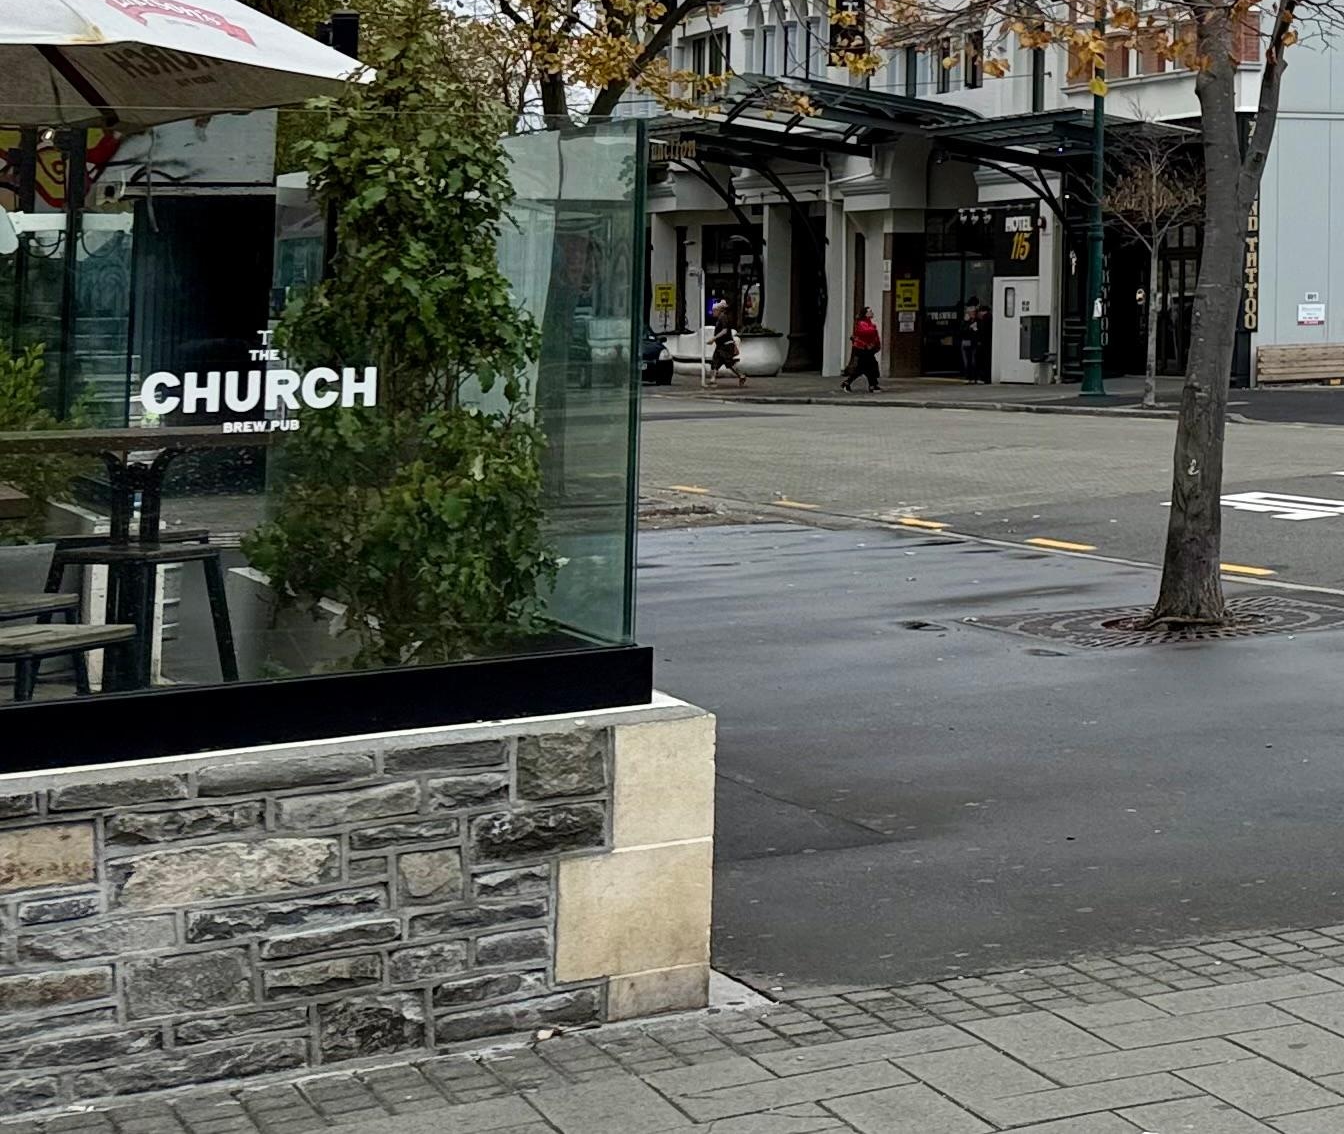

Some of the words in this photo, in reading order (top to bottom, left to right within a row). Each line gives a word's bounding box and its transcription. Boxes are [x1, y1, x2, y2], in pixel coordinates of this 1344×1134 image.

[1010, 232, 1033, 261] 115
[249, 349, 279, 361] THE
[141, 367, 377, 415] CHURCH
[223, 421, 266, 433] BREW
[271, 419, 300, 432] PUB
